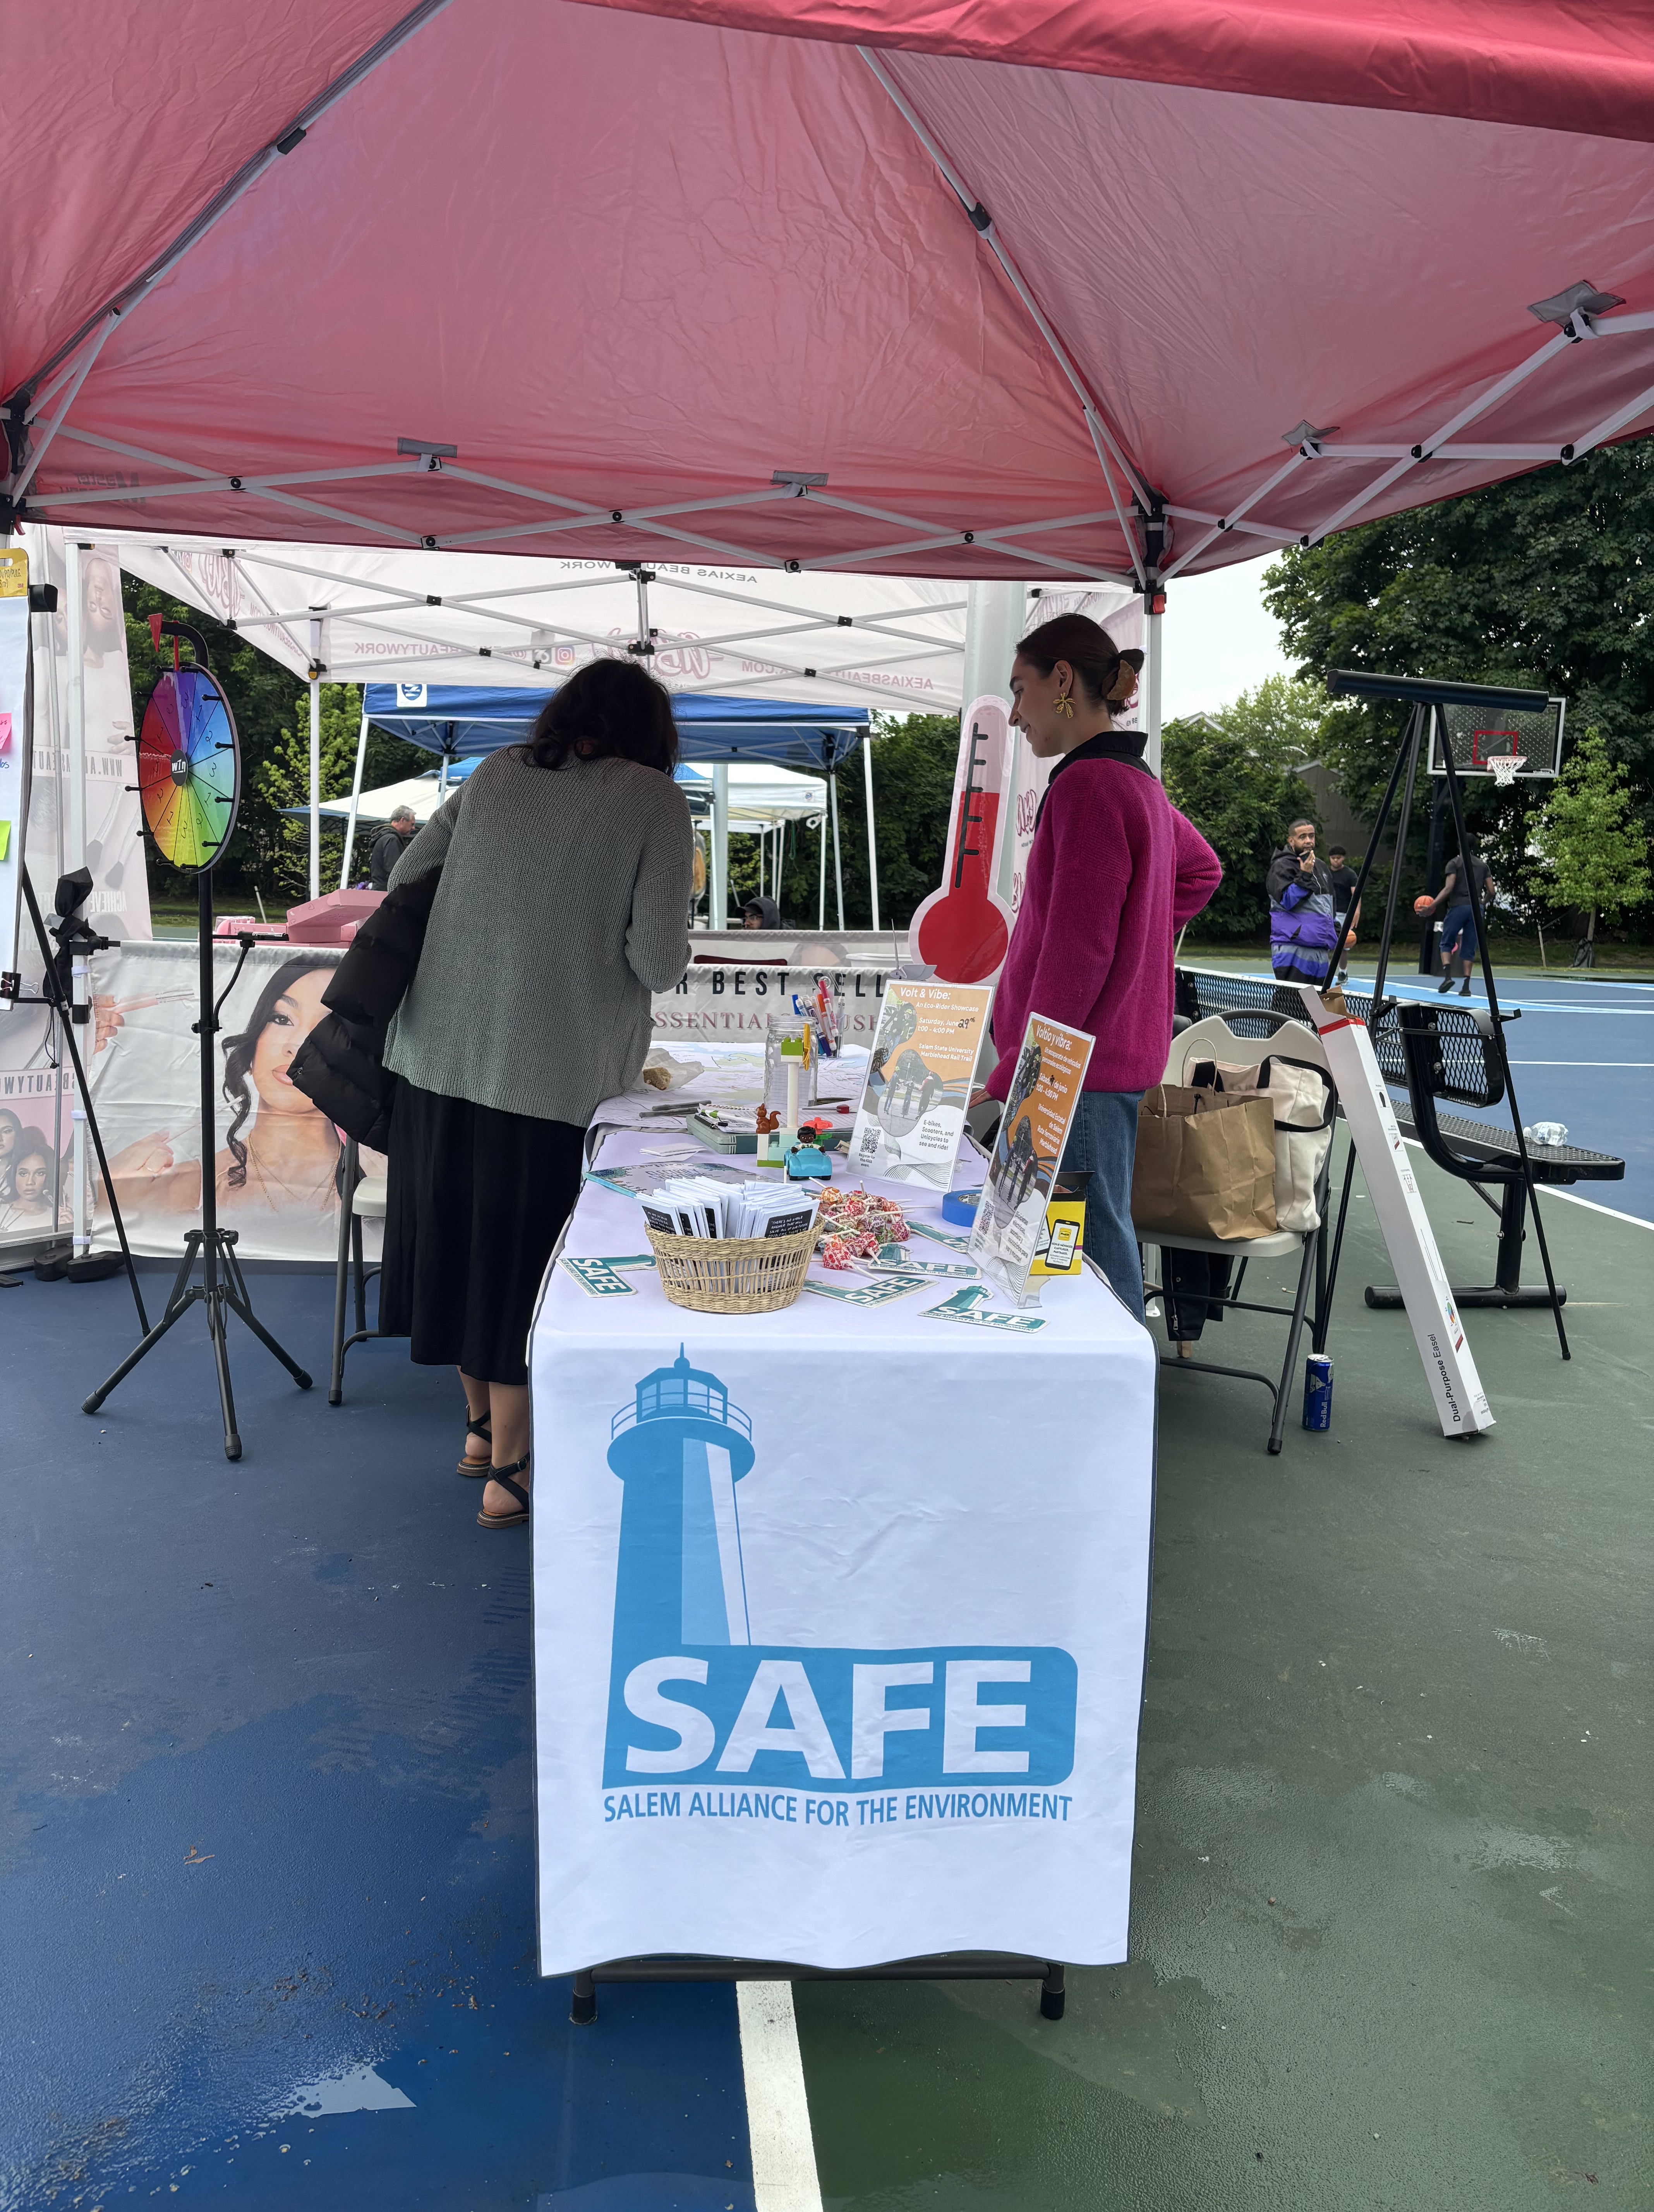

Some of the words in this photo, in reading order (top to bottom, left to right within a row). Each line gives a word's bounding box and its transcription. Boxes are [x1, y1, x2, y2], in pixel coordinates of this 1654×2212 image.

[712, 971, 790, 995] BEST
[901, 987, 918, 997] Volt
[920, 988, 925, 998] &
[929, 989, 951, 1000] Vibe:
[919, 1017, 945, 1026] Saturday,
[1036, 1024, 1052, 1042] Voltio
[1050, 1034, 1056, 1046] y
[1055, 1032, 1072, 1051] vibra:
[921, 1051, 951, 1059] Marblehead
[949, 1046, 974, 1055] University
[922, 1127, 944, 1136] Scooters,
[923, 1120, 942, 1128] E-bikes,
[921, 1133, 943, 1142] Unicycles
[572, 1259, 627, 1291] SAFE
[880, 1259, 968, 1274] SAFE
[844, 1278, 918, 1302] SAFE
[933, 1306, 1036, 1327] SAFE
[1428, 1334, 1441, 1358] Easel
[1438, 1360, 1461, 1422] Dual-Purpose
[624, 1656, 1031, 1779] SAFE
[604, 1792, 680, 1822] SALEM
[688, 1792, 797, 1822] ALLIANCE
[806, 1799, 849, 1826] FOR
[856, 1796, 897, 1825] THE
[906, 1793, 1072, 1821] ENVIRONMENT
